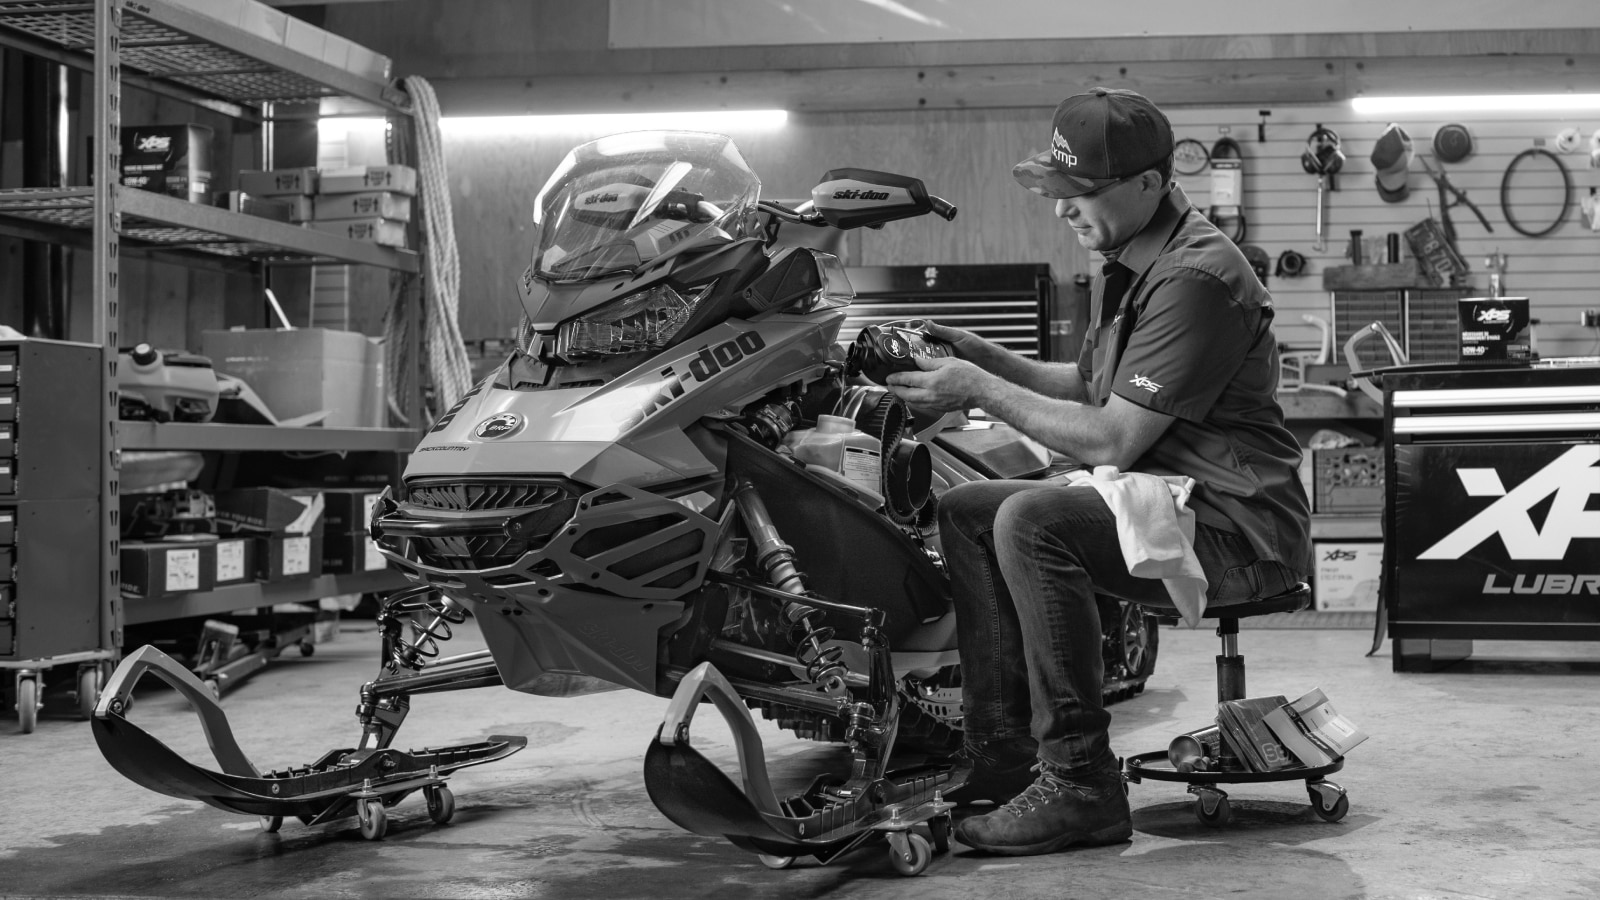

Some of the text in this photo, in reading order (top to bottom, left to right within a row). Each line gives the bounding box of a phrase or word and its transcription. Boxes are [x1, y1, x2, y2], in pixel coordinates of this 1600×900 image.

[138, 135, 172, 150] XPS
[584, 192, 619, 205] ski-doo
[832, 189, 890, 200] ski-doo
[1476, 307, 1512, 321] XPS
[1128, 373, 1165, 393] XPS
[1322, 548, 1358, 562] XPS
